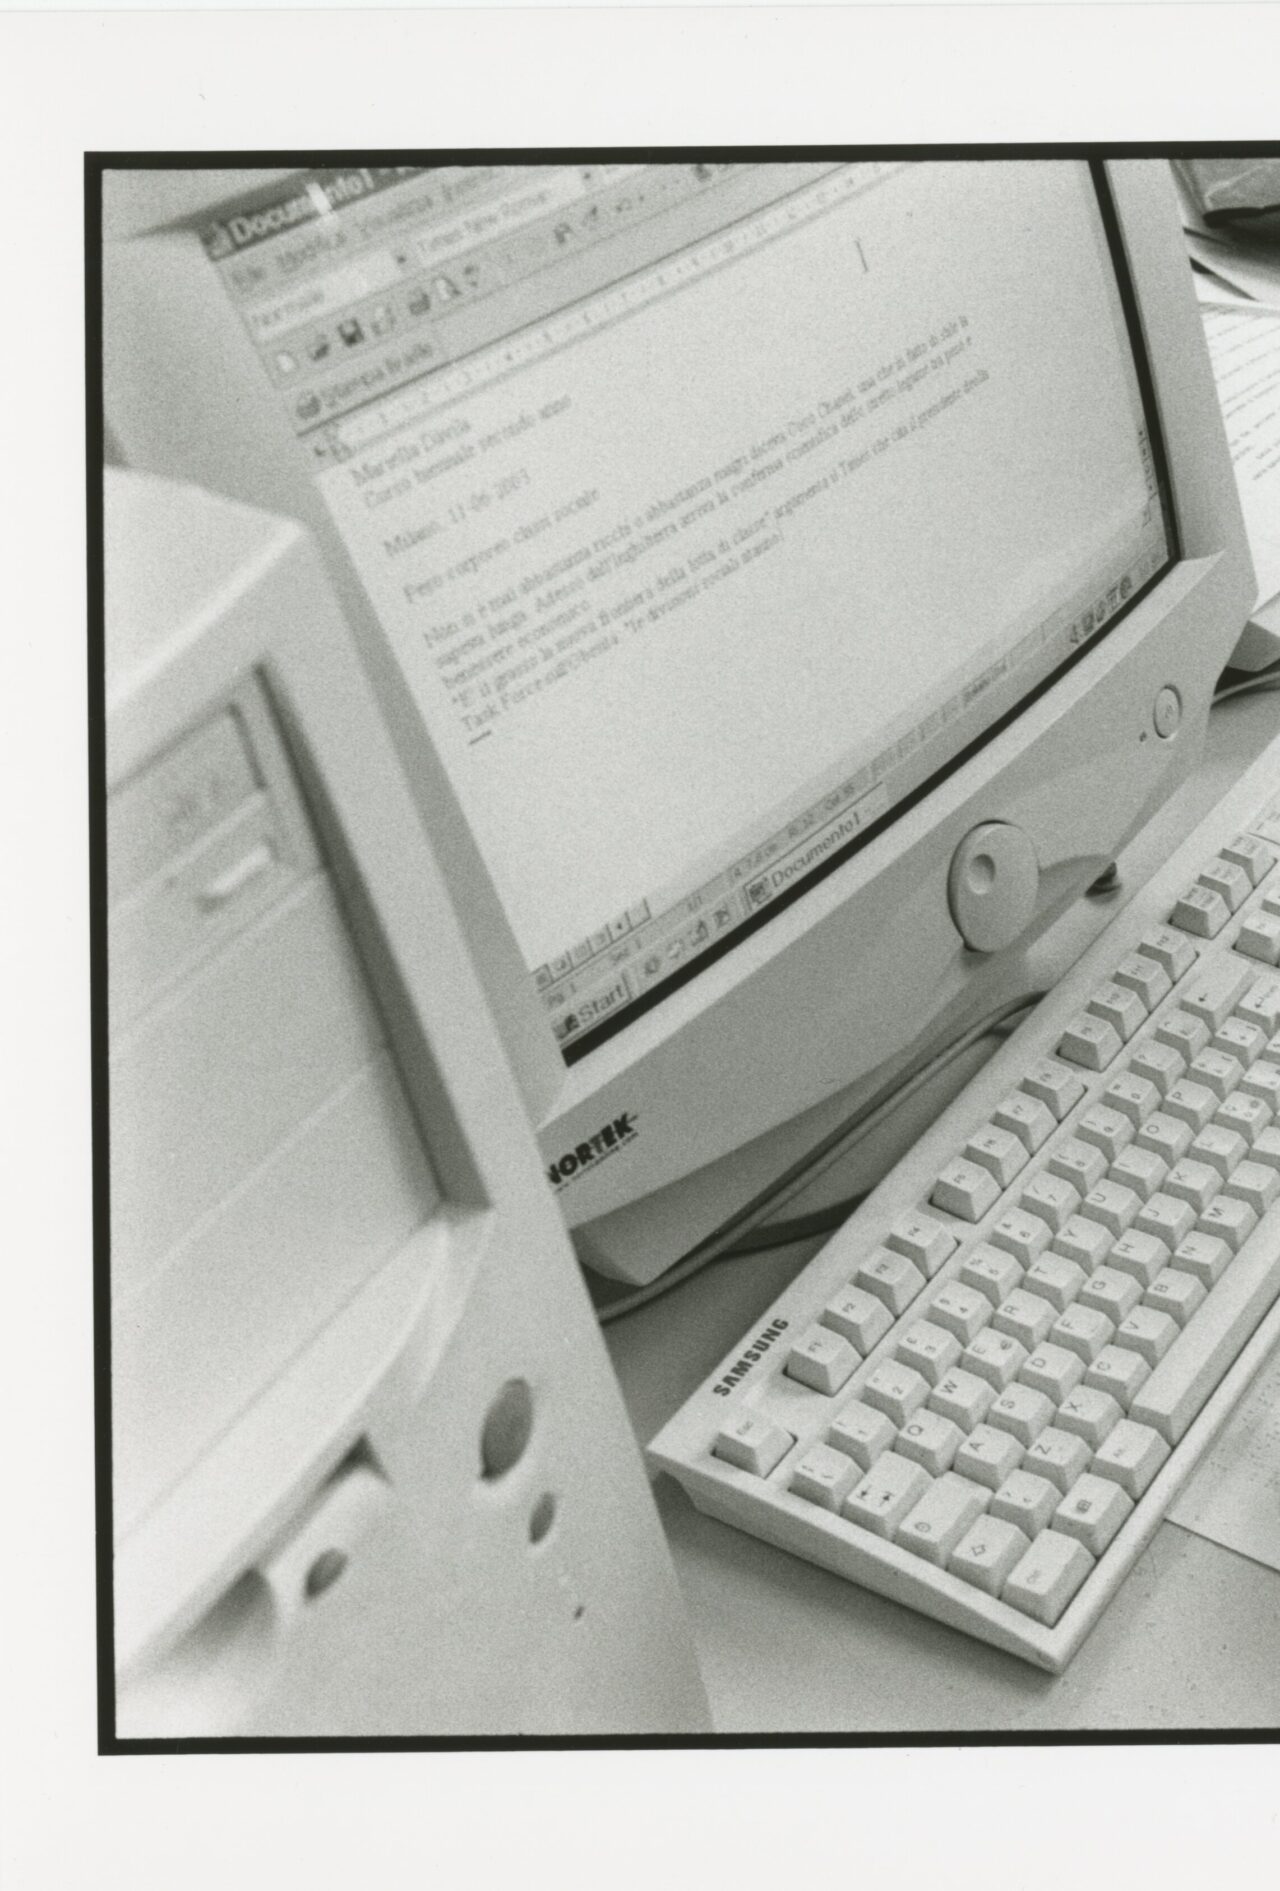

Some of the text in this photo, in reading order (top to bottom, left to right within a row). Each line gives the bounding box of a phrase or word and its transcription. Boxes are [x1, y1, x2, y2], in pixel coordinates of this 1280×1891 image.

[227, 169, 375, 246] Documnto1
[461, 702, 500, 732] Task
[500, 677, 544, 711] Force
[770, 811, 863, 888] Documento1
[579, 983, 625, 1023] Start
[711, 1317, 789, 1397] SAMSUNG
